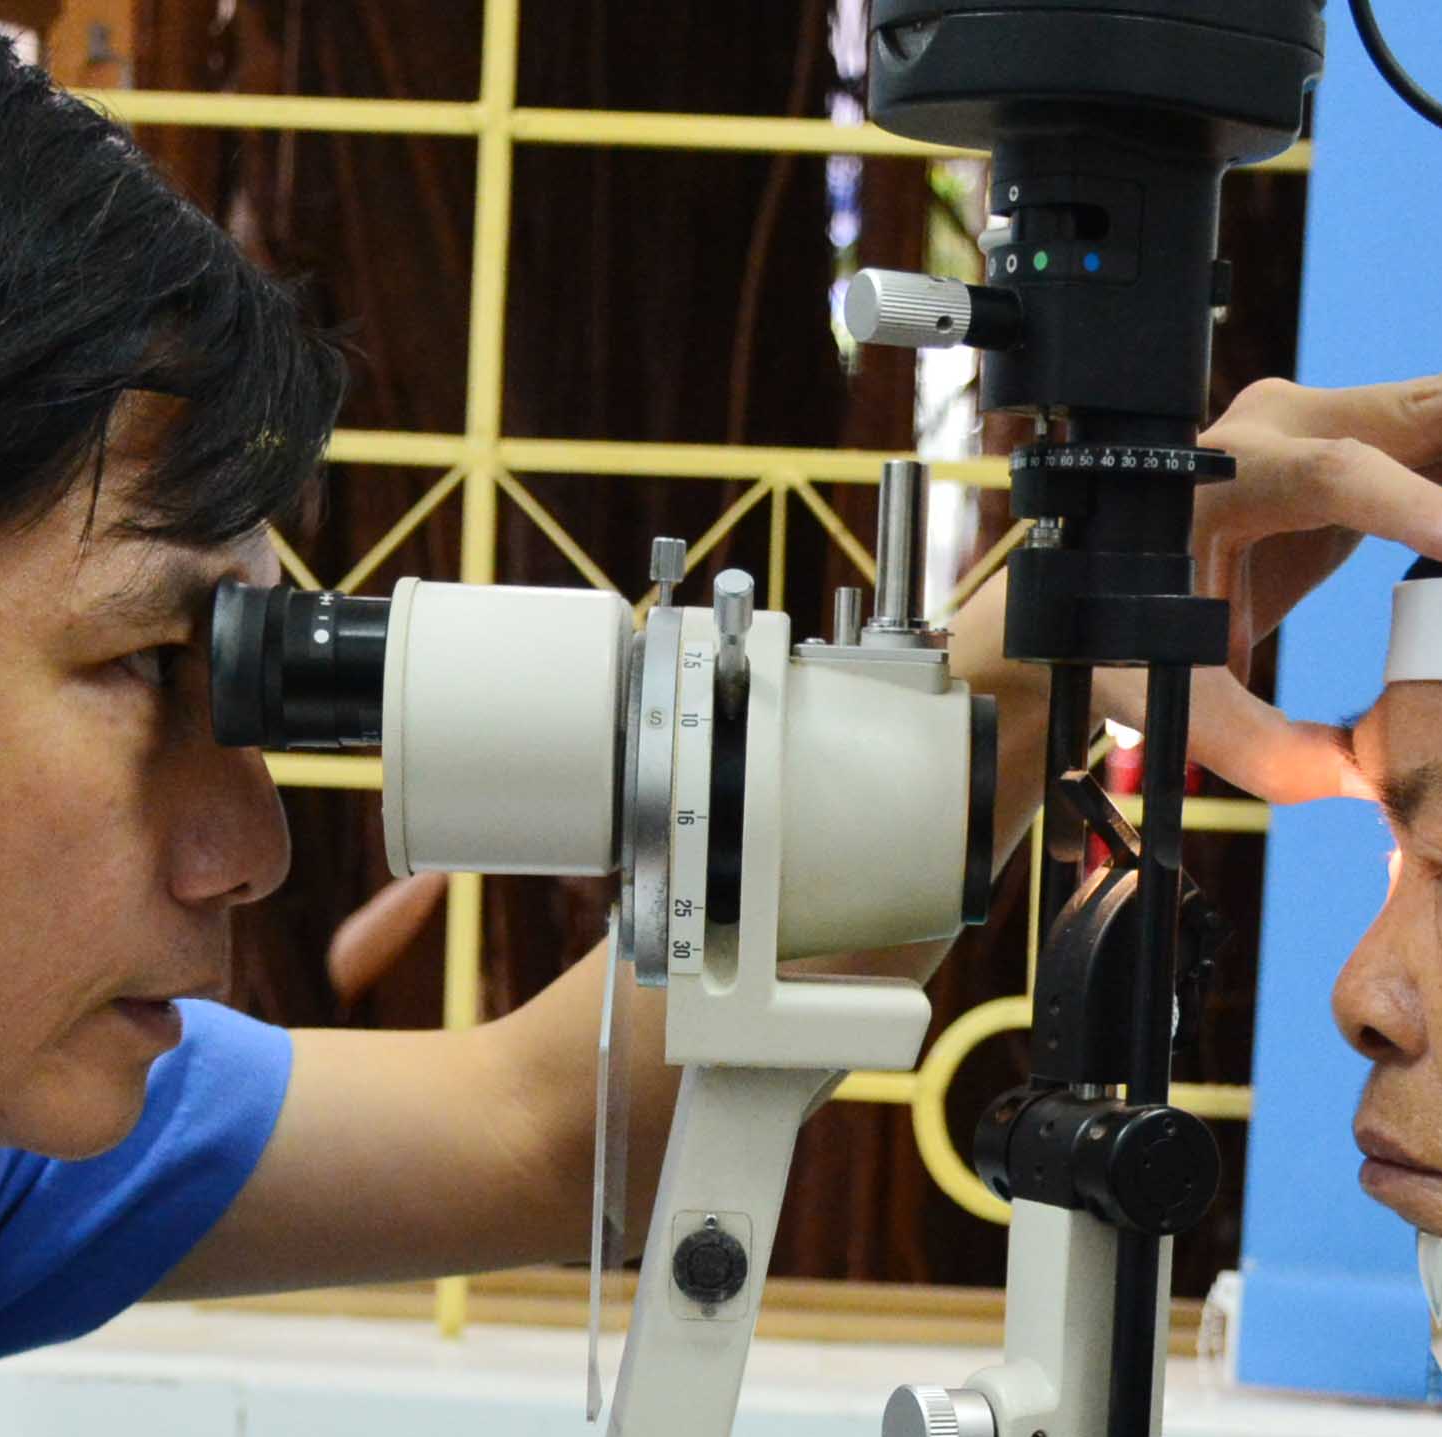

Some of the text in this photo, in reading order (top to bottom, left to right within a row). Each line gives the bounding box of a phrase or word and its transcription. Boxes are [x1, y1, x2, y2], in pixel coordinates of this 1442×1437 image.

[1060, 456, 1074, 466] 60
[1079, 456, 1094, 467] 50
[1100, 456, 1116, 467] 40
[1121, 457, 1136, 468] 30
[1143, 457, 1159, 468] 20
[1166, 459, 1179, 470] 10
[1188, 460, 1196, 471] 0
[649, 710, 663, 726] S
[672, 652, 702, 959] 7.5 10 16 25 30
